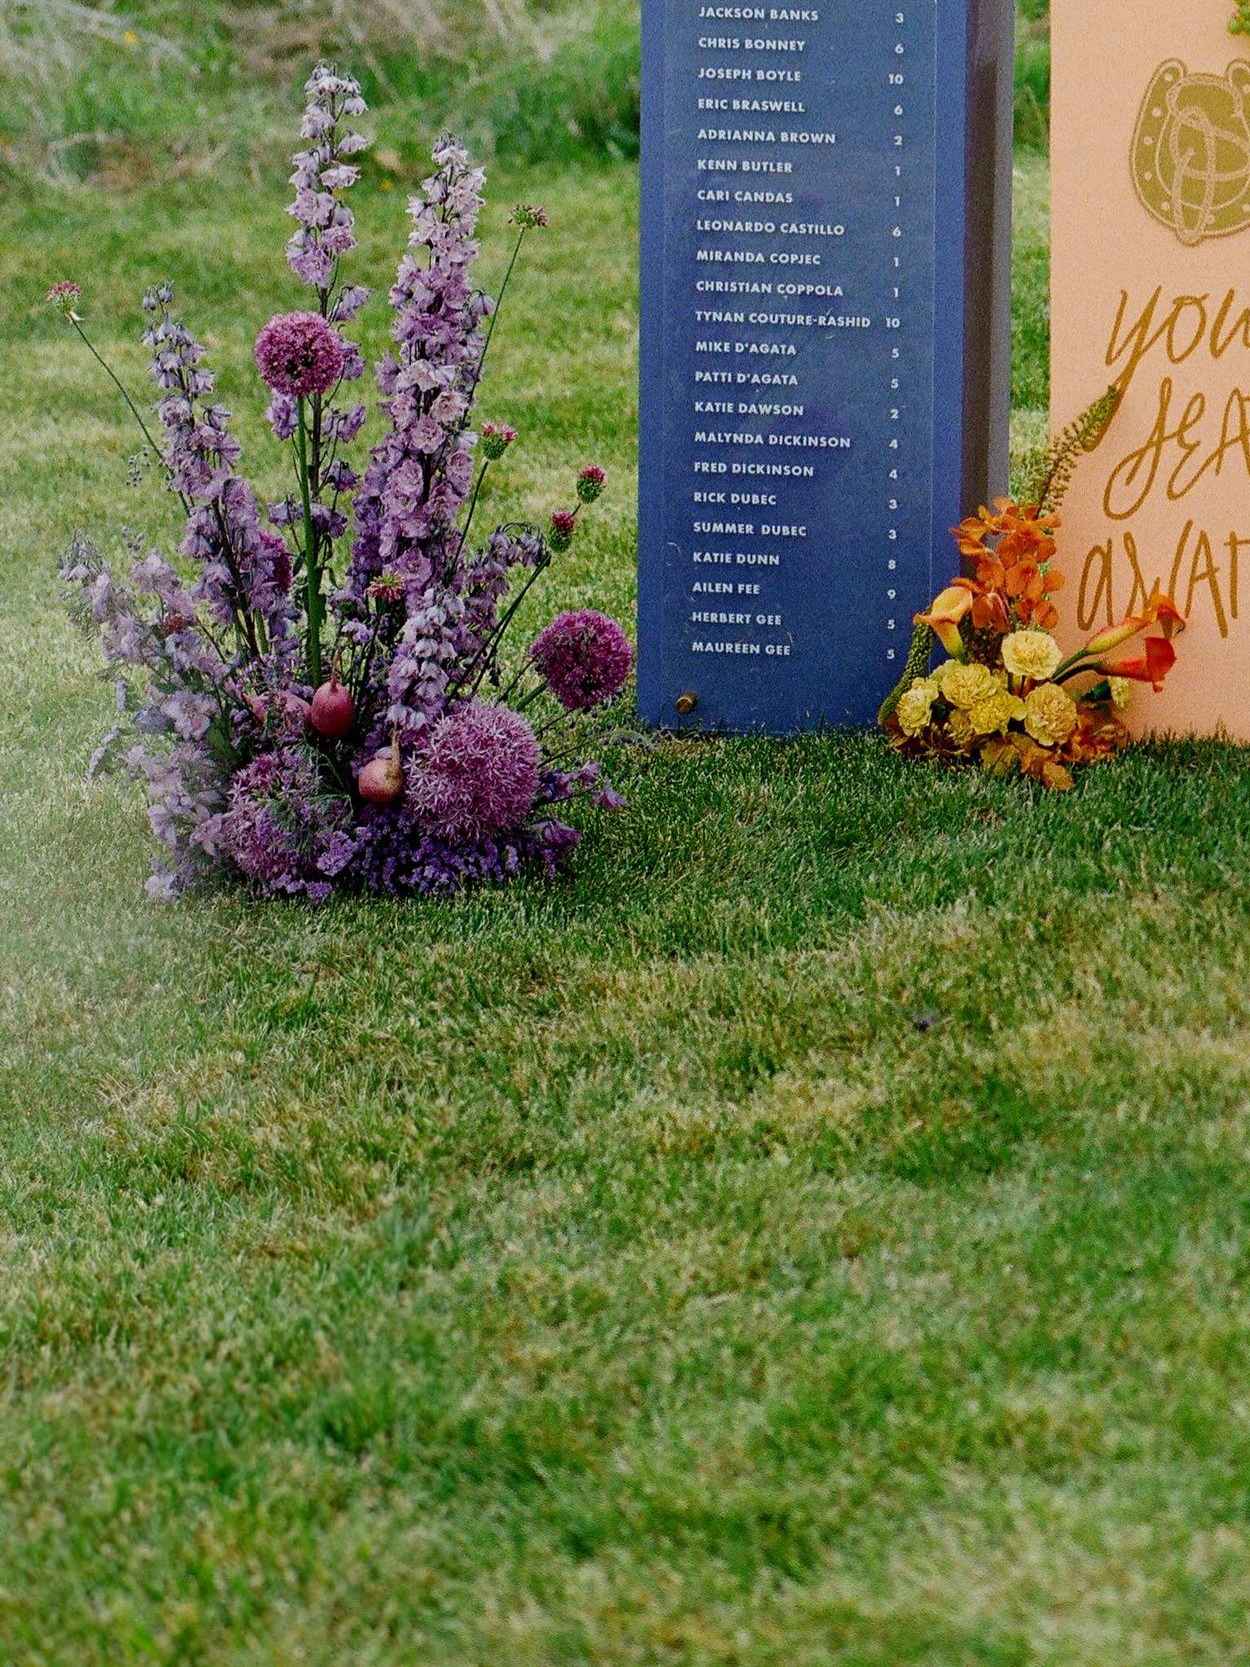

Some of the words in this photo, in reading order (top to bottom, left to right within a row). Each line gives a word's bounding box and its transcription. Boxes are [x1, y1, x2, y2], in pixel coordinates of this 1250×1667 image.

[698, 6, 765, 19] JACKSON
[769, 8, 819, 22] BANKS
[895, 12, 904, 24] 3
[698, 36, 740, 49] CHRIS
[744, 38, 806, 51] BONNEY
[894, 43, 904, 55] 6
[698, 67, 752, 80] JOSEPH
[755, 69, 801, 82] BOYLE
[888, 73, 904, 85] 10
[697, 128, 776, 142] ADRIANNA
[780, 131, 836, 144] BROWN
[893, 134, 903, 146] 2
[696, 219, 776, 233] LEONARDO
[779, 222, 845, 236] CASTILLO
[891, 226, 902, 238] 6
[695, 280, 773, 294] CHRISTIAN
[776, 283, 844, 297] COPPOLA
[893, 286, 899, 298] 1
[695, 340, 731, 353] MIKE
[734, 342, 797, 355] D'AGATA
[891, 347, 900, 359] 5
[694, 401, 734, 414] KATIE
[737, 402, 804, 416] DAWSON
[890, 408, 899, 420] 2
[694, 431, 764, 445] MALYNDA
[768, 434, 851, 448] DICKINSON
[888, 438, 899, 450] 4
[693, 461, 728, 474] FRED
[731, 462, 815, 477] DICKINSON
[888, 468, 898, 480] 4
[692, 520, 755, 535] SUMMER
[760, 524, 807, 537] DUBEC
[888, 528, 897, 541] 3
[691, 581, 734, 594] AILEN
[737, 583, 761, 595] FEE
[886, 588, 897, 600] 9
[691, 640, 761, 655] MAUREEN
[764, 644, 791, 656] GEE
[886, 648, 895, 660] 5
